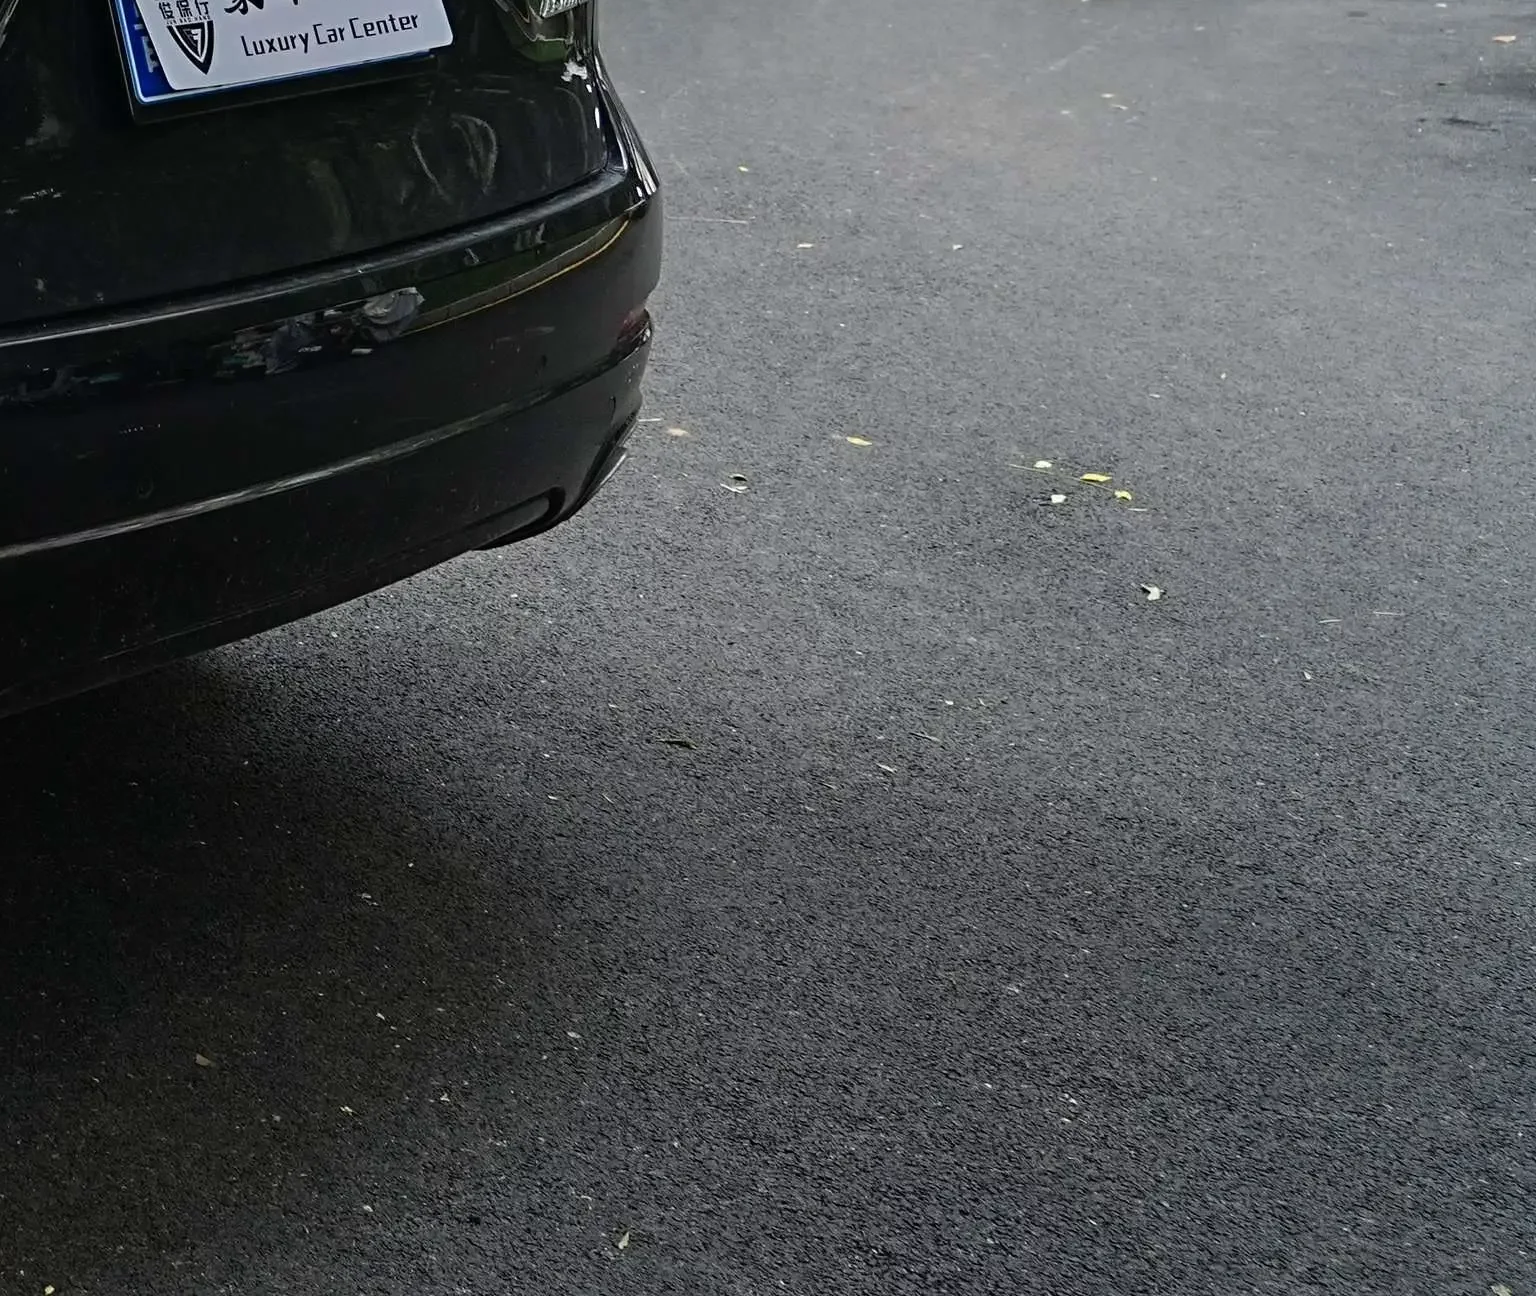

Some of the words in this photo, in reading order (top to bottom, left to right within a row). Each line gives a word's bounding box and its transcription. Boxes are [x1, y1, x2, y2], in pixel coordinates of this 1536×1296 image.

[241, 33, 309, 57] Luxury
[313, 23, 345, 46] Car
[349, 13, 418, 39] Center
